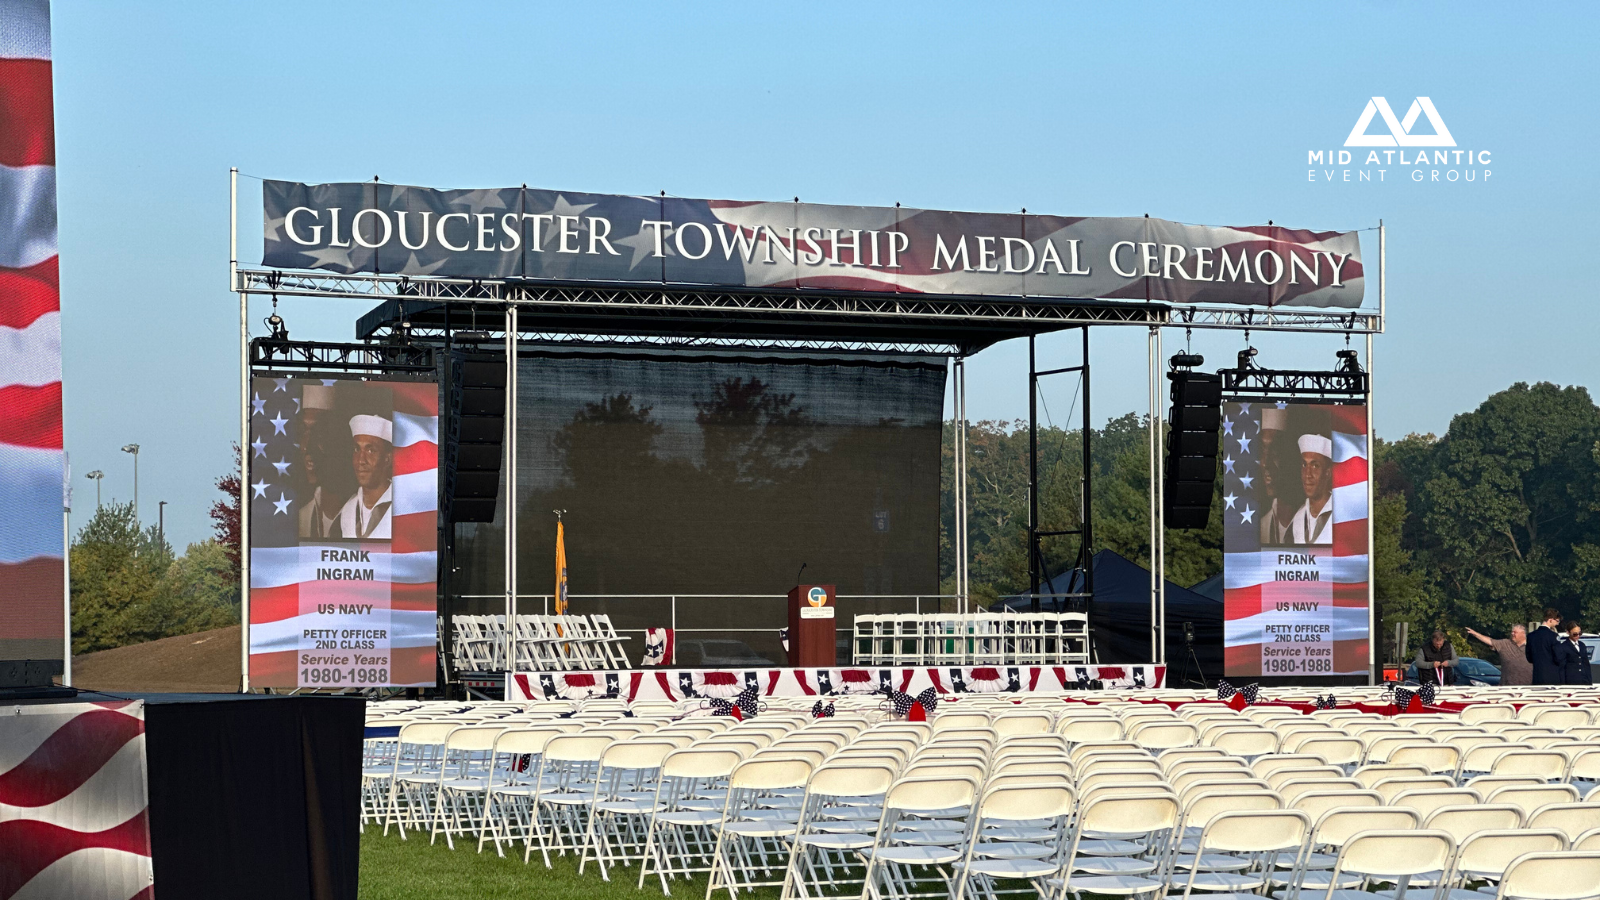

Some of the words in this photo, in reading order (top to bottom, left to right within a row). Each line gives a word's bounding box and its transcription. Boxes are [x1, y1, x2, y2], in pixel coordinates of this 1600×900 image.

[284, 206, 621, 256] GLOUCESTER
[642, 219, 909, 268] TOWNSHIP
[930, 233, 1090, 276] MEDAL
[1109, 241, 1350, 287] CEREMONY
[321, 550, 371, 562] FRANK
[1278, 554, 1316, 565] FRANK
[316, 568, 374, 581] INGRAM
[1275, 570, 1320, 581] INGRAM
[317, 604, 335, 614] US
[338, 604, 373, 614] NAVY
[1276, 602, 1290, 611] US
[1292, 602, 1319, 611] NAVY
[303, 629, 338, 639] PETTY
[341, 629, 387, 639] OFFICER
[1265, 624, 1292, 633] PETTY
[1294, 624, 1330, 633] OFFICER
[1275, 634, 1292, 642] 2ND
[1294, 634, 1321, 642] CLASS
[315, 640, 337, 650] 2ND
[340, 640, 375, 650] CLASS
[1263, 646, 1301, 657] Service
[1304, 646, 1331, 656] Years
[300, 654, 349, 665] Service
[353, 654, 388, 665] Years
[1263, 659, 1332, 672] 1980-1988
[300, 668, 388, 683] 1980-1988
